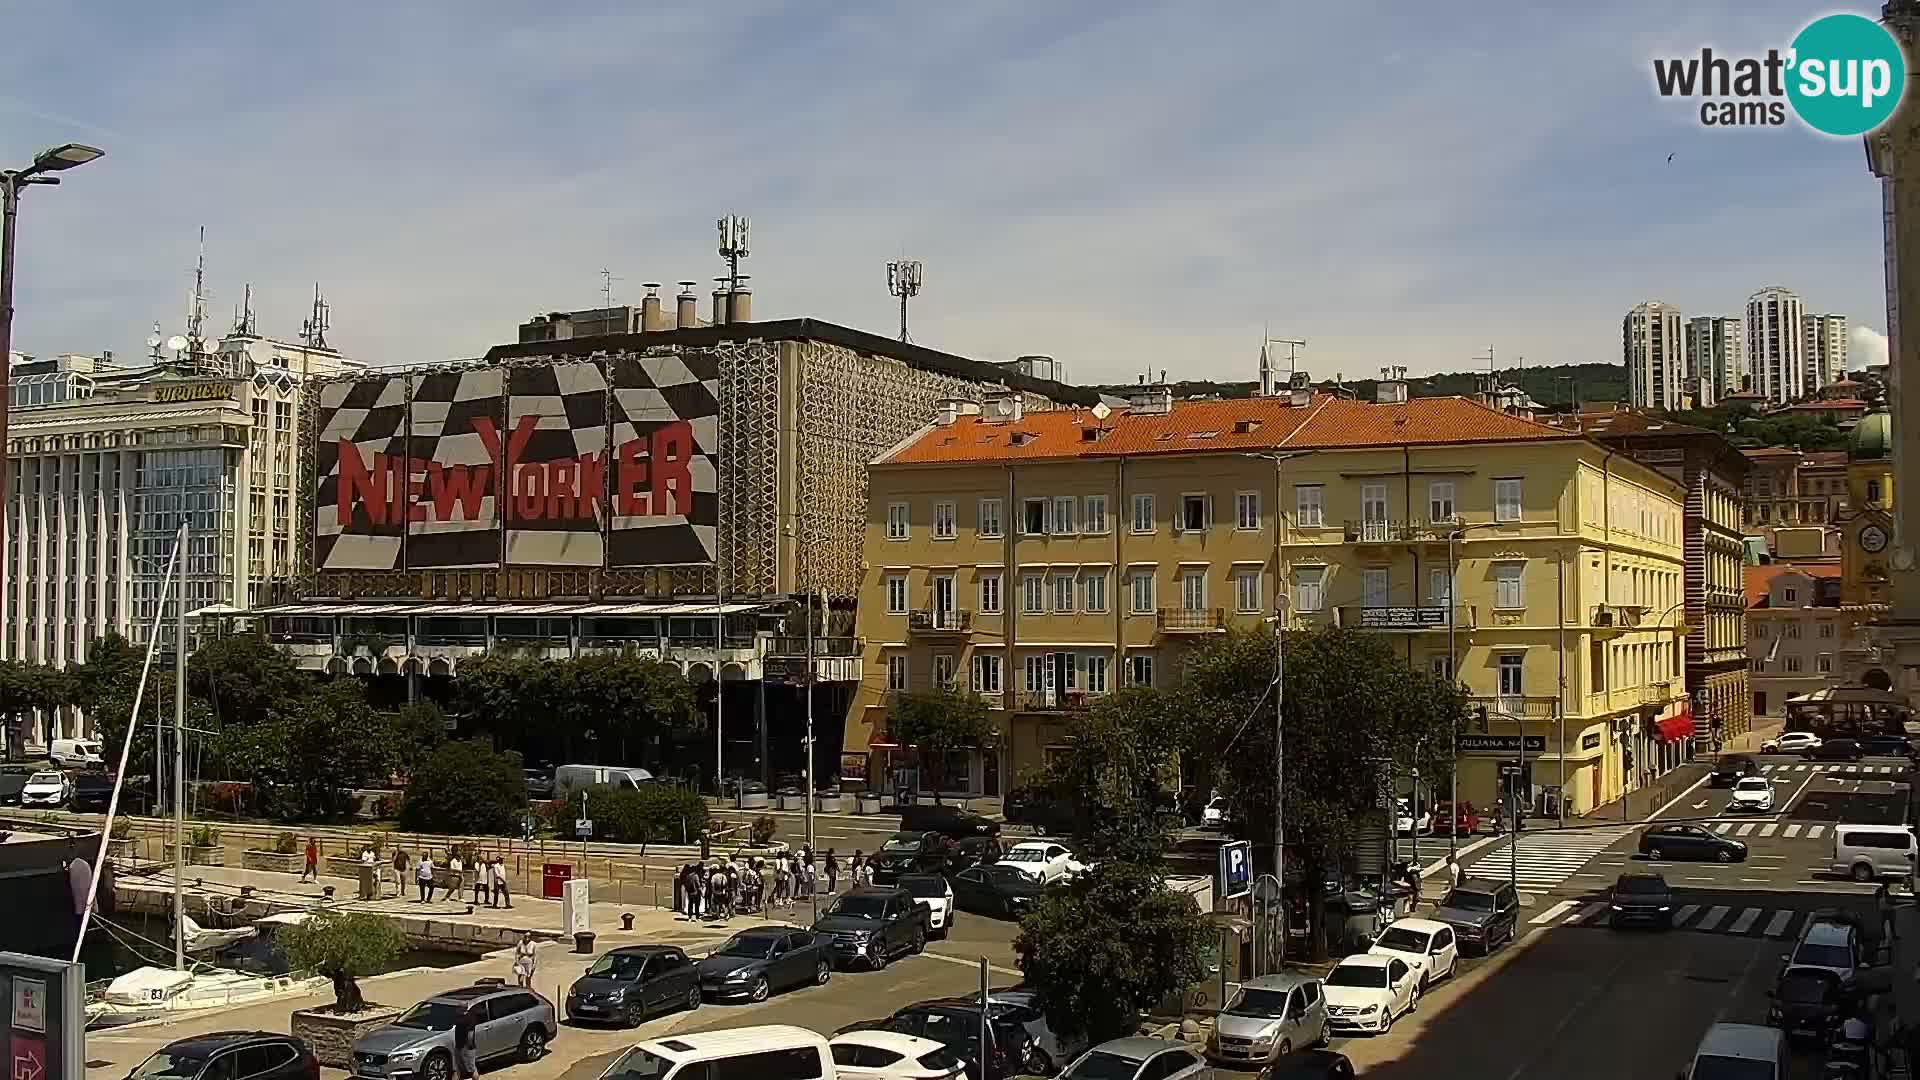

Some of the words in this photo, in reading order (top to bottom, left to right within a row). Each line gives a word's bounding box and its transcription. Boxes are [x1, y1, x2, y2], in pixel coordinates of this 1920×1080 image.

[337, 436, 494, 526] NEW
[469, 414, 693, 522] YORKER
[1459, 739, 1504, 748] JULIANA
[1230, 849, 1243, 873] P
